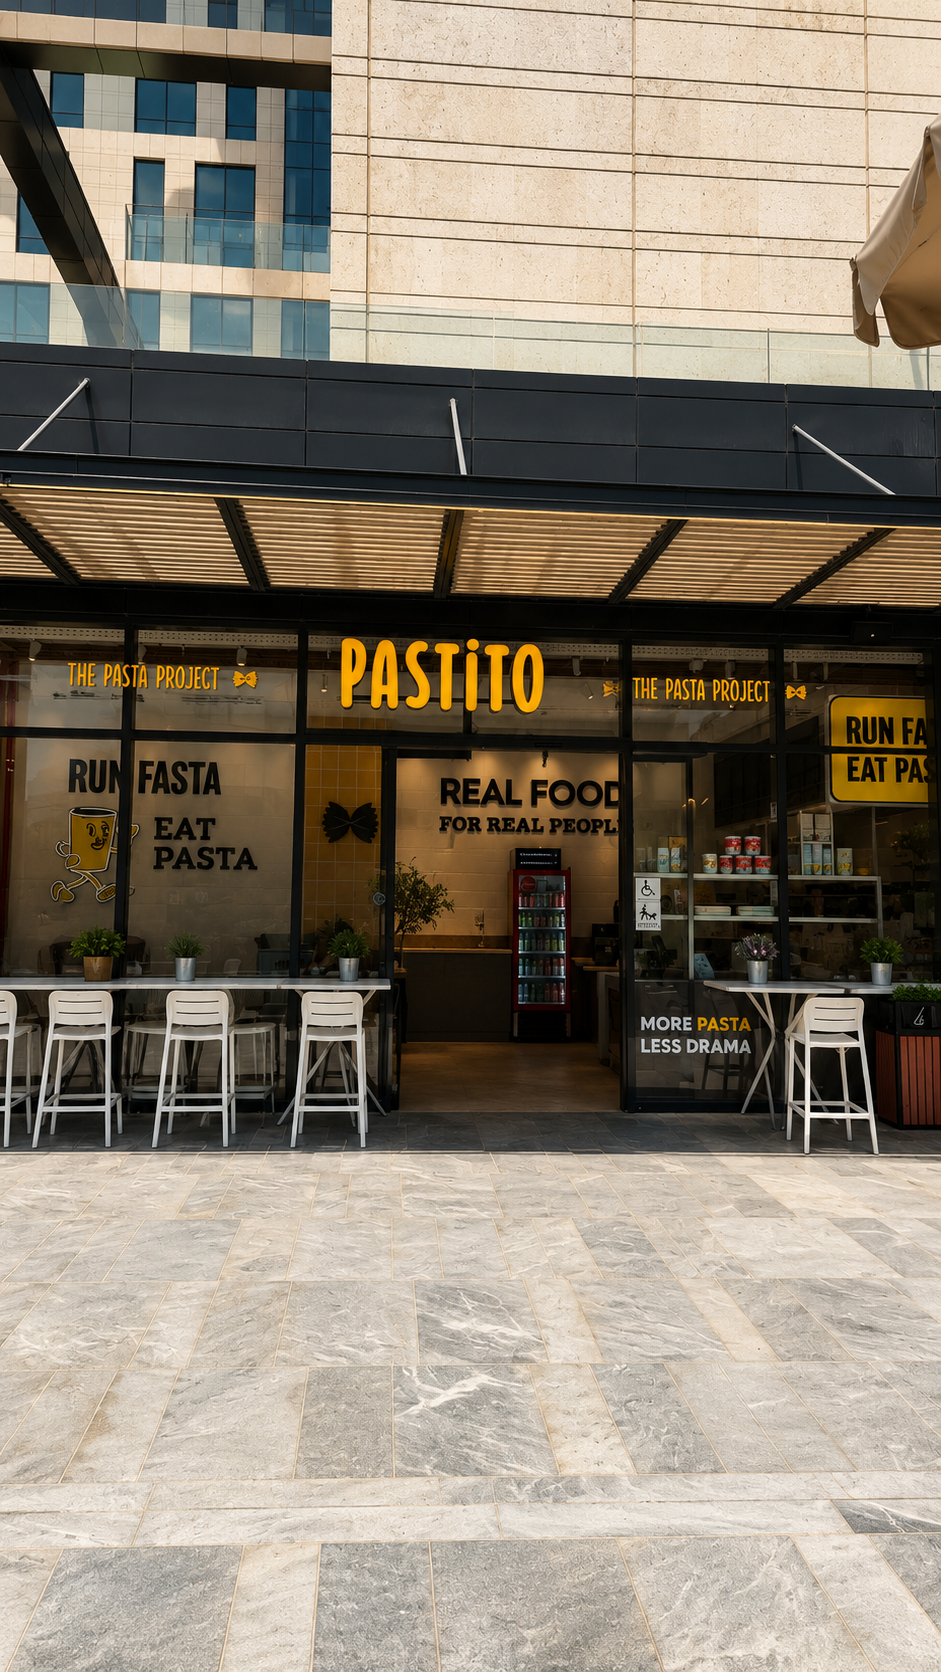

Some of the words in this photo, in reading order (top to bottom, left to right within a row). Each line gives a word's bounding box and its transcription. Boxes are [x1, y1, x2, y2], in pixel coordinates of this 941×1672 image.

[68, 662, 96, 687] THE
[104, 664, 148, 688] PASTA
[156, 665, 220, 690] PROJECT
[632, 677, 658, 699] THE
[666, 678, 705, 701] PASTA
[713, 680, 770, 702] PROJECT
[846, 716, 894, 744] RUN
[138, 761, 221, 795] FASTA
[847, 756, 887, 782] EAT
[440, 778, 522, 806] REAL
[154, 817, 216, 840] EAT
[439, 816, 482, 832] FOR
[487, 817, 544, 833] REAL
[549, 818, 619, 834] PEOPL
[153, 846, 258, 870] PASTA
[641, 1016, 692, 1031] MORE
[697, 1017, 752, 1031] PASTA
[641, 1038, 682, 1053] LESS
[686, 1039, 752, 1053] DRAMA
